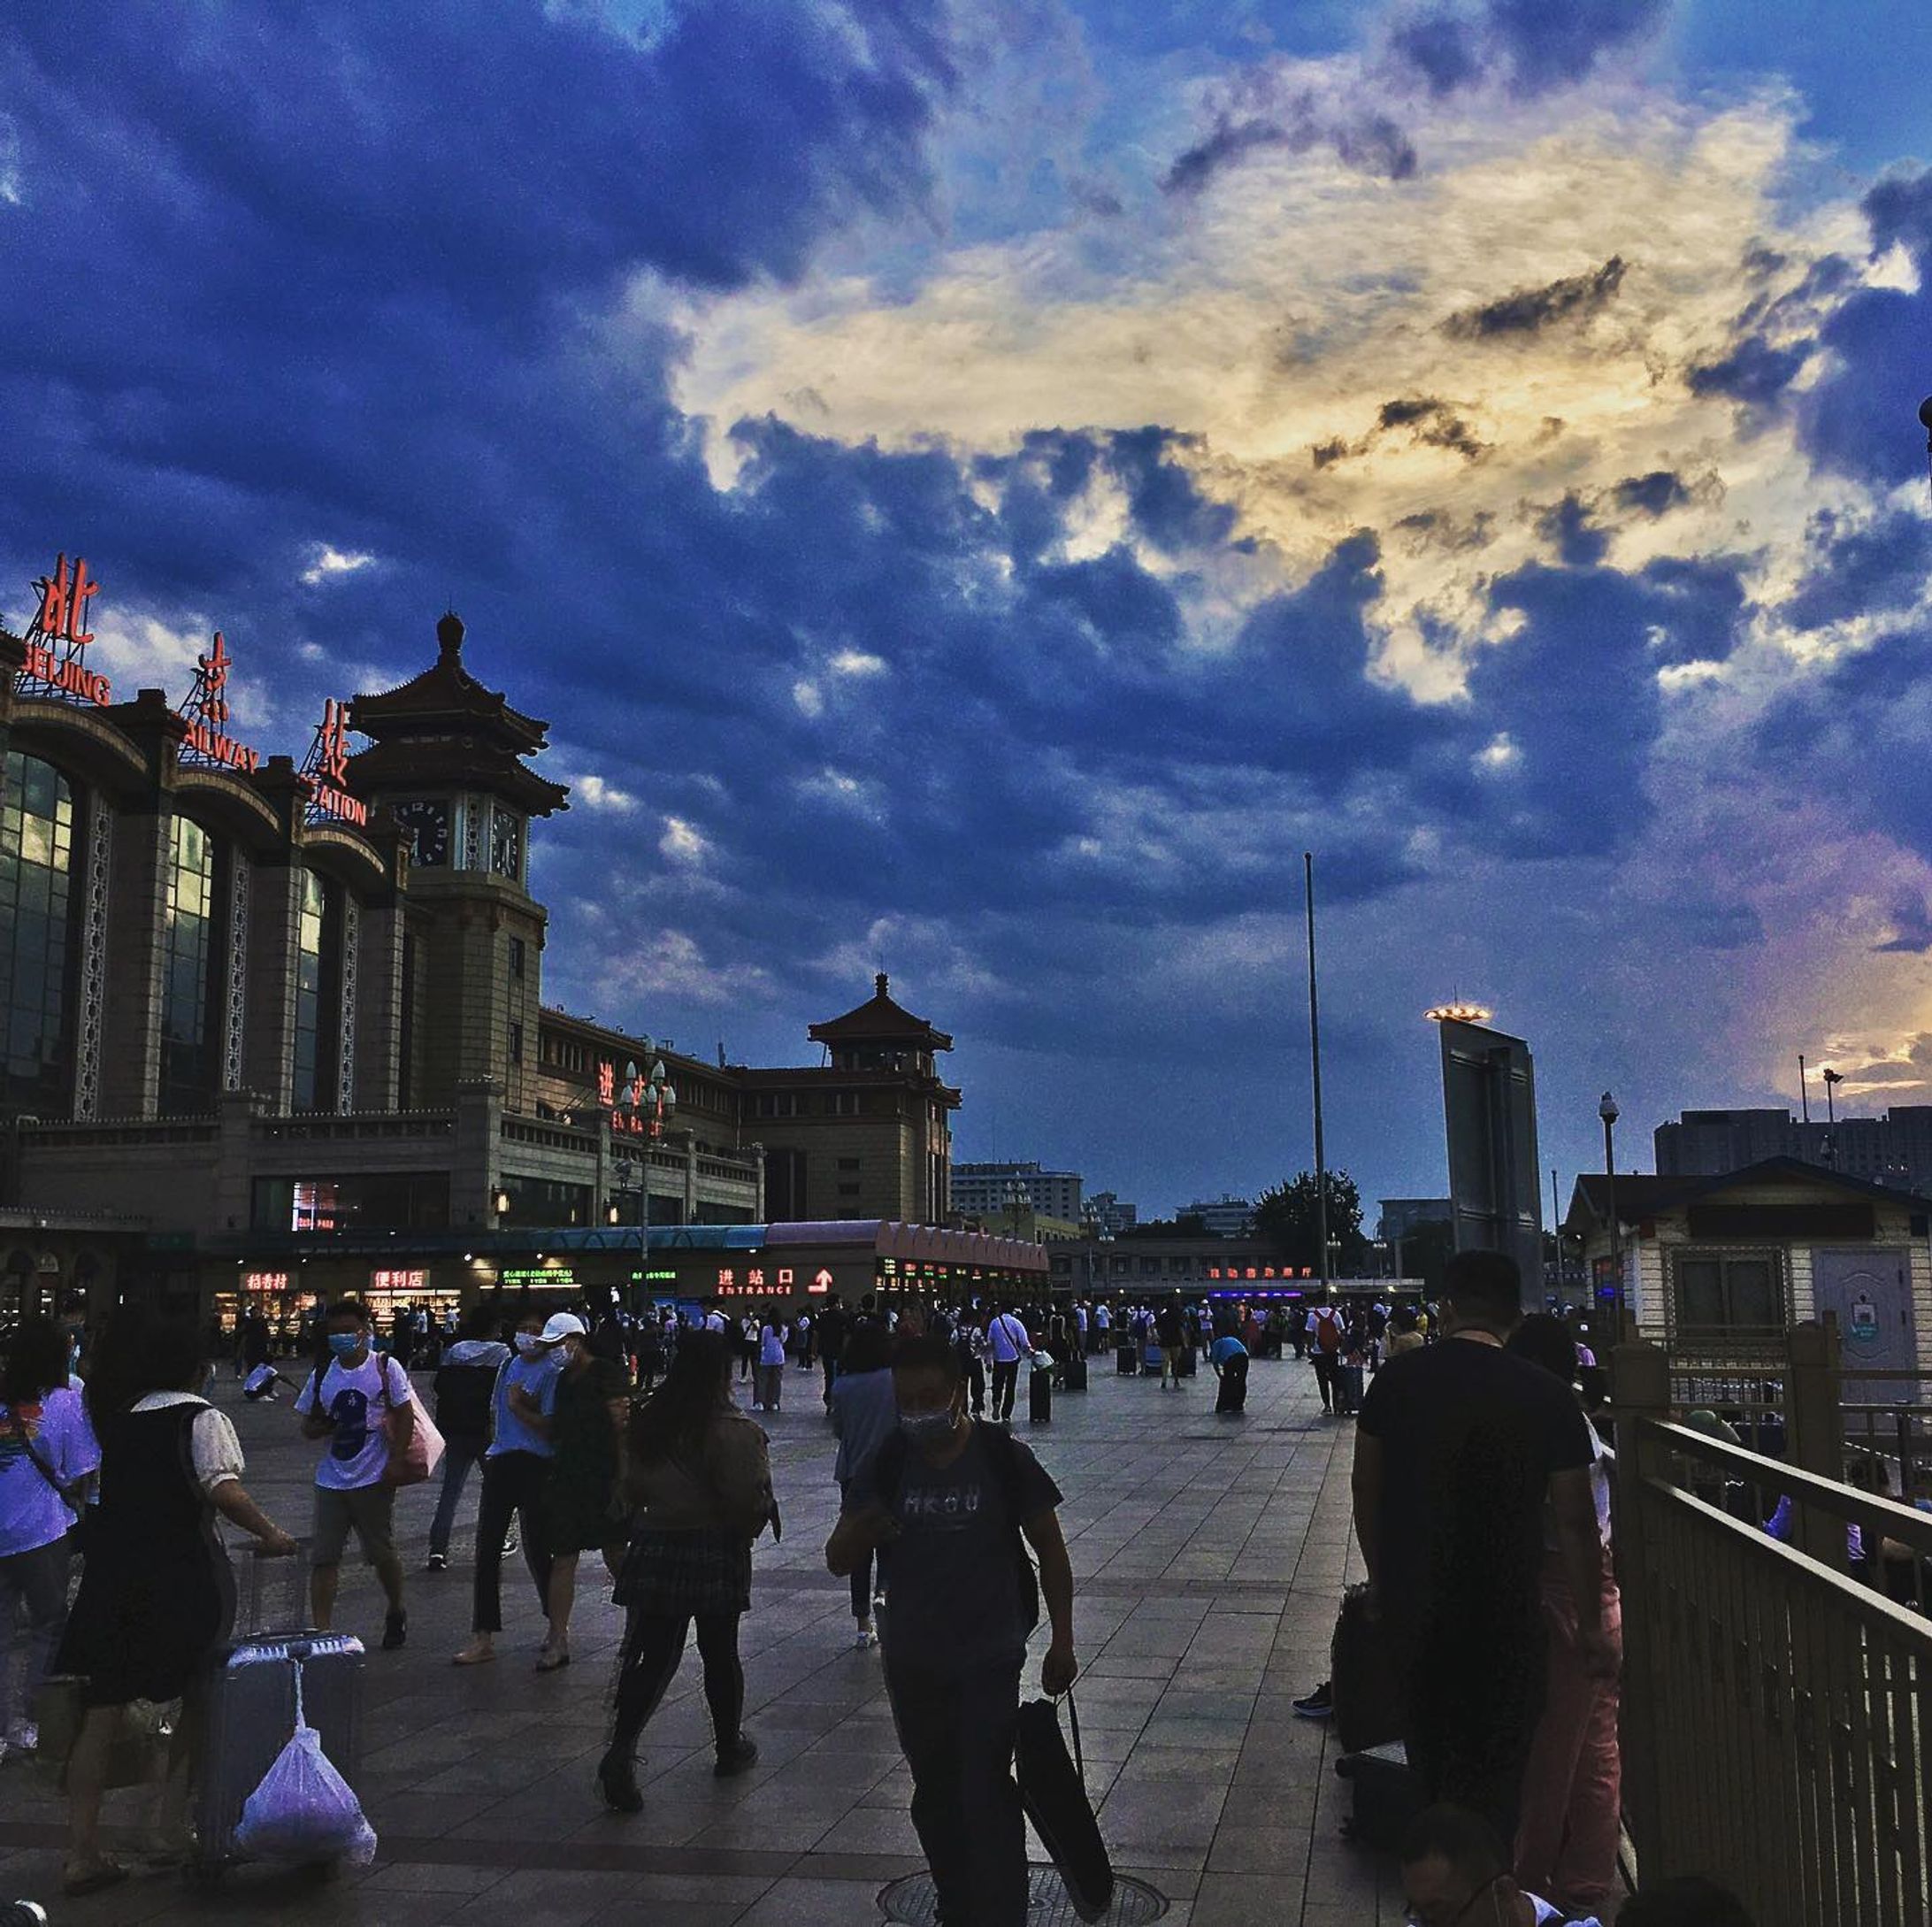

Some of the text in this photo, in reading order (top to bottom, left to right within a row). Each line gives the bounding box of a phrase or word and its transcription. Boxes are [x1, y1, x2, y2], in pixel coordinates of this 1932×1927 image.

[41, 552, 99, 643] 北
[198, 631, 232, 722] 京
[183, 718, 259, 774] AILWAY
[247, 1273, 288, 1290] 稻香村
[374, 1271, 424, 1288] 便利店
[719, 1269, 793, 1285] 进站口
[718, 1286, 792, 1295] ENTRANCE
